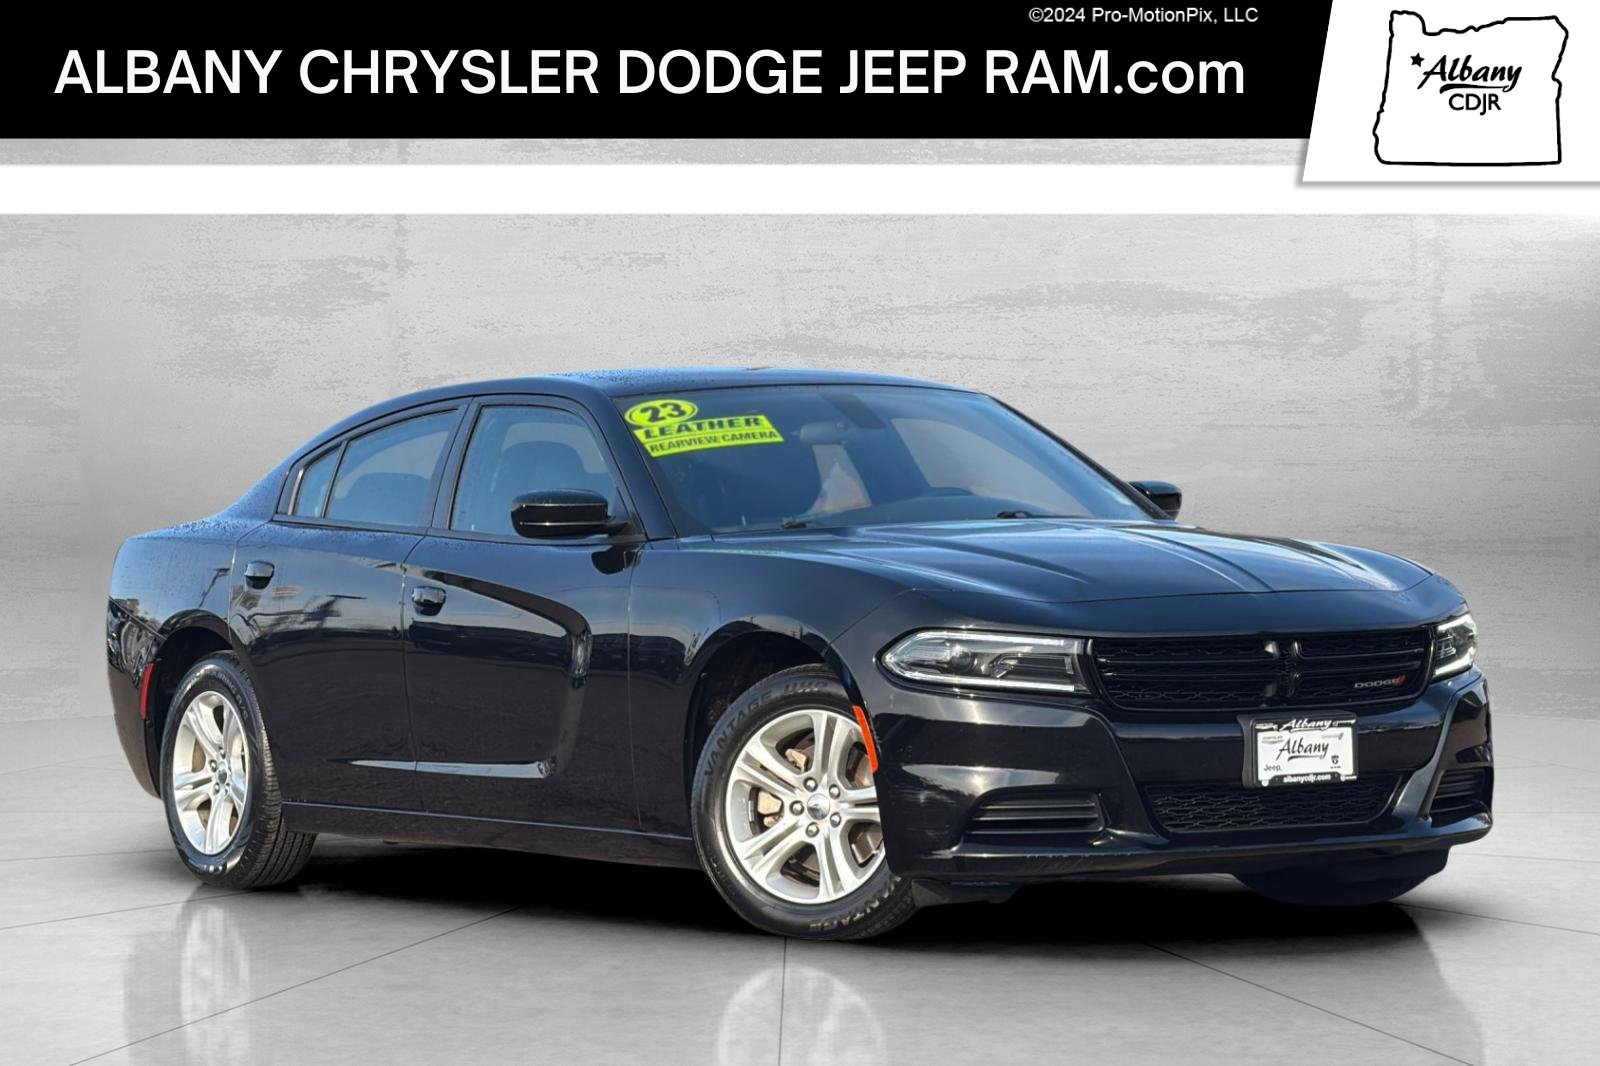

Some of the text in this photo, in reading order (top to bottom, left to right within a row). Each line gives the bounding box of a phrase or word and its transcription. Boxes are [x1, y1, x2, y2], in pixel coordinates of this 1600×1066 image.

[640, 402, 687, 423] 23
[643, 417, 762, 440] LEATHER
[649, 431, 778, 453] REARVIEW CAMERA
[1354, 678, 1400, 689] DODGE
[1279, 718, 1333, 733] Albany
[1276, 737, 1330, 760] Albany
